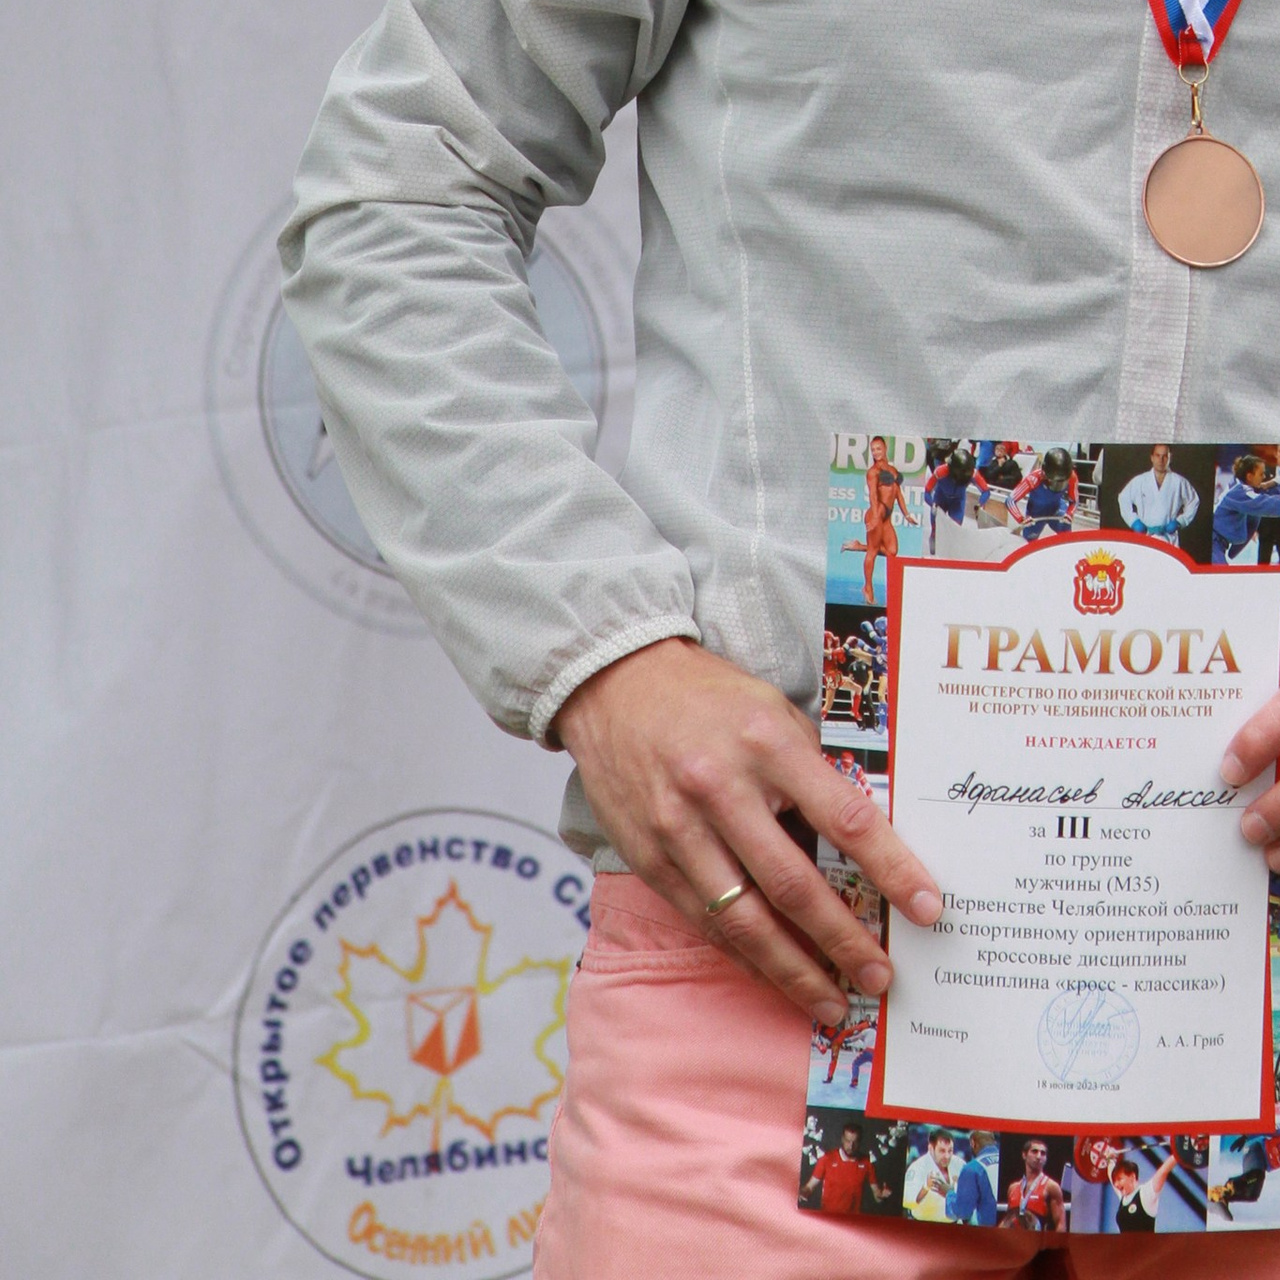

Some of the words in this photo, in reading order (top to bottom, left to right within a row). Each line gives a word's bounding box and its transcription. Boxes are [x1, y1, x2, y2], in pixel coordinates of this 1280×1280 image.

[941, 623, 1242, 675] ГРАМОТА
[938, 683, 1054, 699] МИНИСТЕРСТВО
[1058, 689, 1078, 700] ПО
[1081, 686, 1175, 701] ФИЗИЧЕСКОЙ
[1178, 687, 1243, 700] КУЛЬТУРЕ
[969, 702, 979, 713] И
[982, 703, 1039, 717] СПОРТУ
[1043, 704, 1147, 718] ЧЕЛЯБИНСКОЙ
[1150, 705, 1213, 718] ОБЛАСТИ
[1025, 736, 1157, 750] НАГРАЖДАЕТСЯ
[947, 771, 1104, 815] Афанасьев
[1028, 825, 1046, 838] за
[1055, 815, 1092, 839] III
[1100, 826, 1151, 841] место
[1044, 853, 1066, 867] по
[1071, 853, 1133, 874] группе
[1014, 876, 1101, 894] мужчины
[1106, 876, 1160, 894] (М35)
[942, 893, 1046, 916] Первенстве
[1051, 898, 1168, 919] Челябинской
[1173, 899, 1239, 916] области
[932, 921, 954, 934] по
[959, 922, 1079, 945] спортивному
[1084, 924, 1231, 947] ориентированию
[976, 947, 1073, 968] кроссовые
[1077, 950, 1188, 969] дисциплины
[934, 967, 1050, 992] (дисциплина
[1055, 978, 1117, 996] «кросс
[1133, 973, 1226, 993] классика»)
[261, 940, 313, 1172] Открытое
[311, 836, 541, 932] первенство
[910, 1021, 969, 1042] Министр
[1156, 1035, 1172, 1048] А.
[1175, 1035, 1190, 1048] А.
[1193, 1033, 1225, 1048] Гриб
[1037, 1080, 1048, 1089] 18
[1076, 1080, 1099, 1091] 2023
[1100, 1083, 1120, 1092] года
